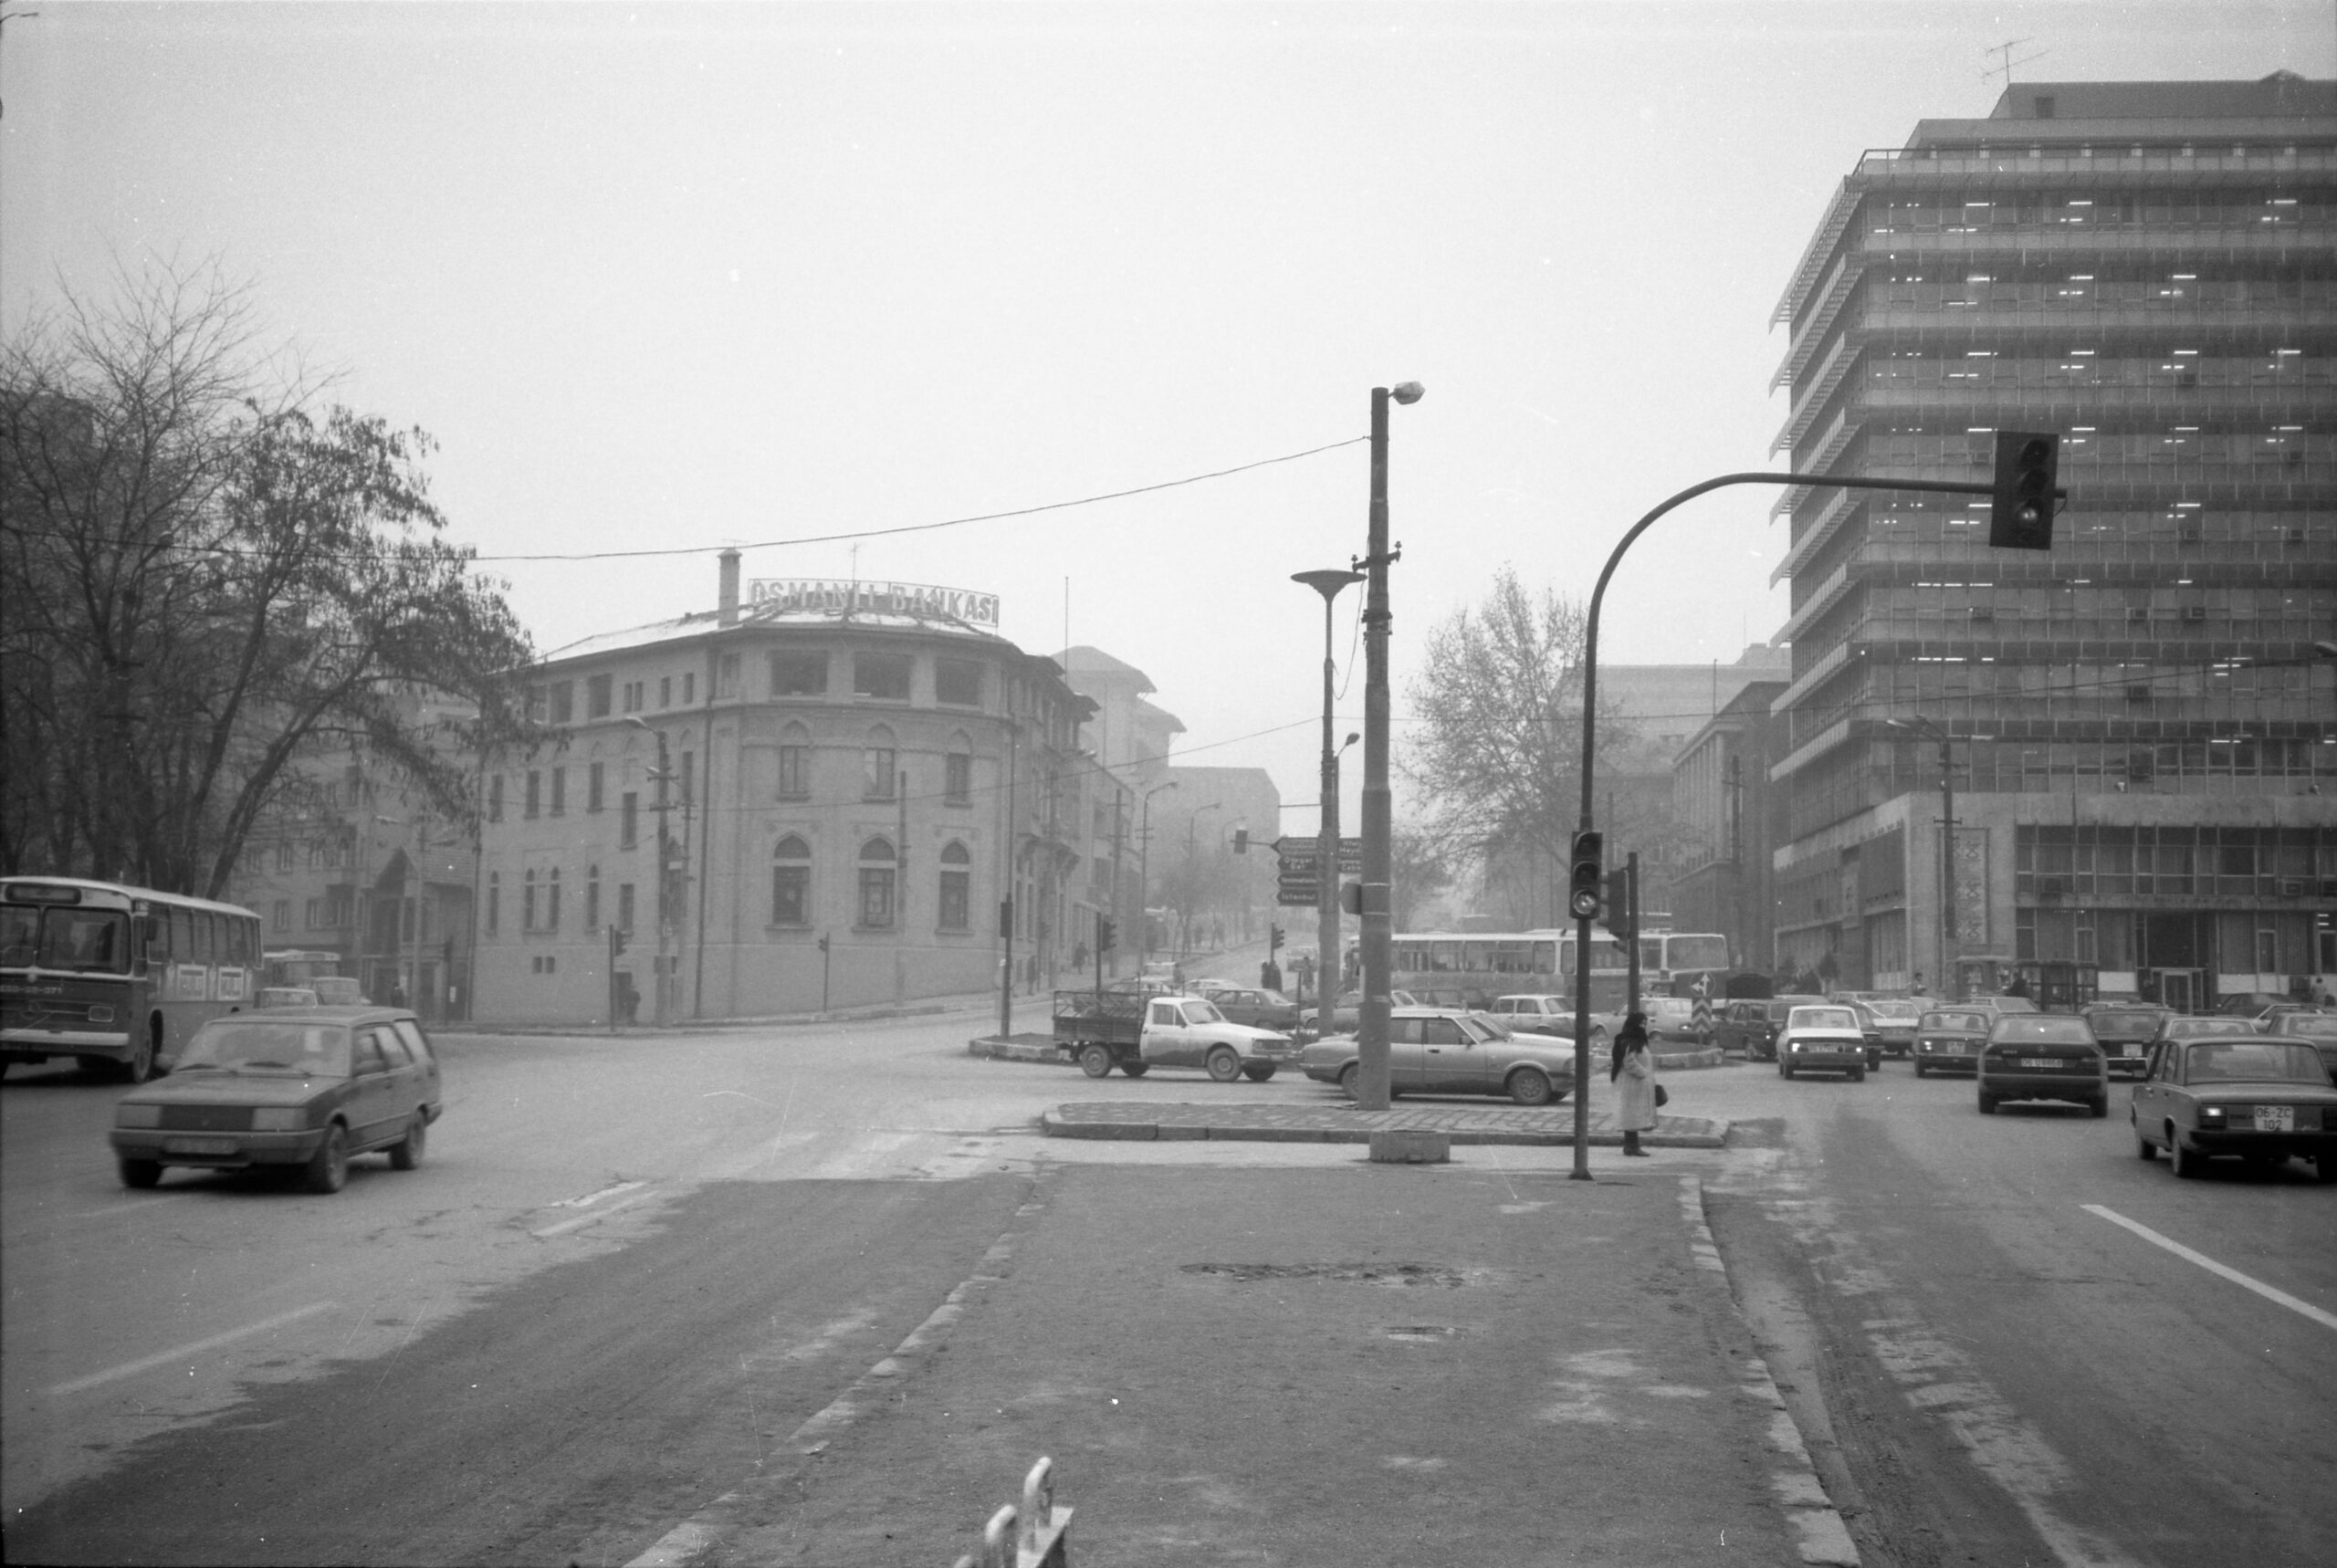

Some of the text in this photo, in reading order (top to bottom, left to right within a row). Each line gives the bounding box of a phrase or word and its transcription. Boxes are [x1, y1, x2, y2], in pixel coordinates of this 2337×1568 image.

[891, 585, 1000, 622] BANKASI
[2256, 1107, 2292, 1118] 06-ZC
[2264, 1119, 2283, 1130] 102
